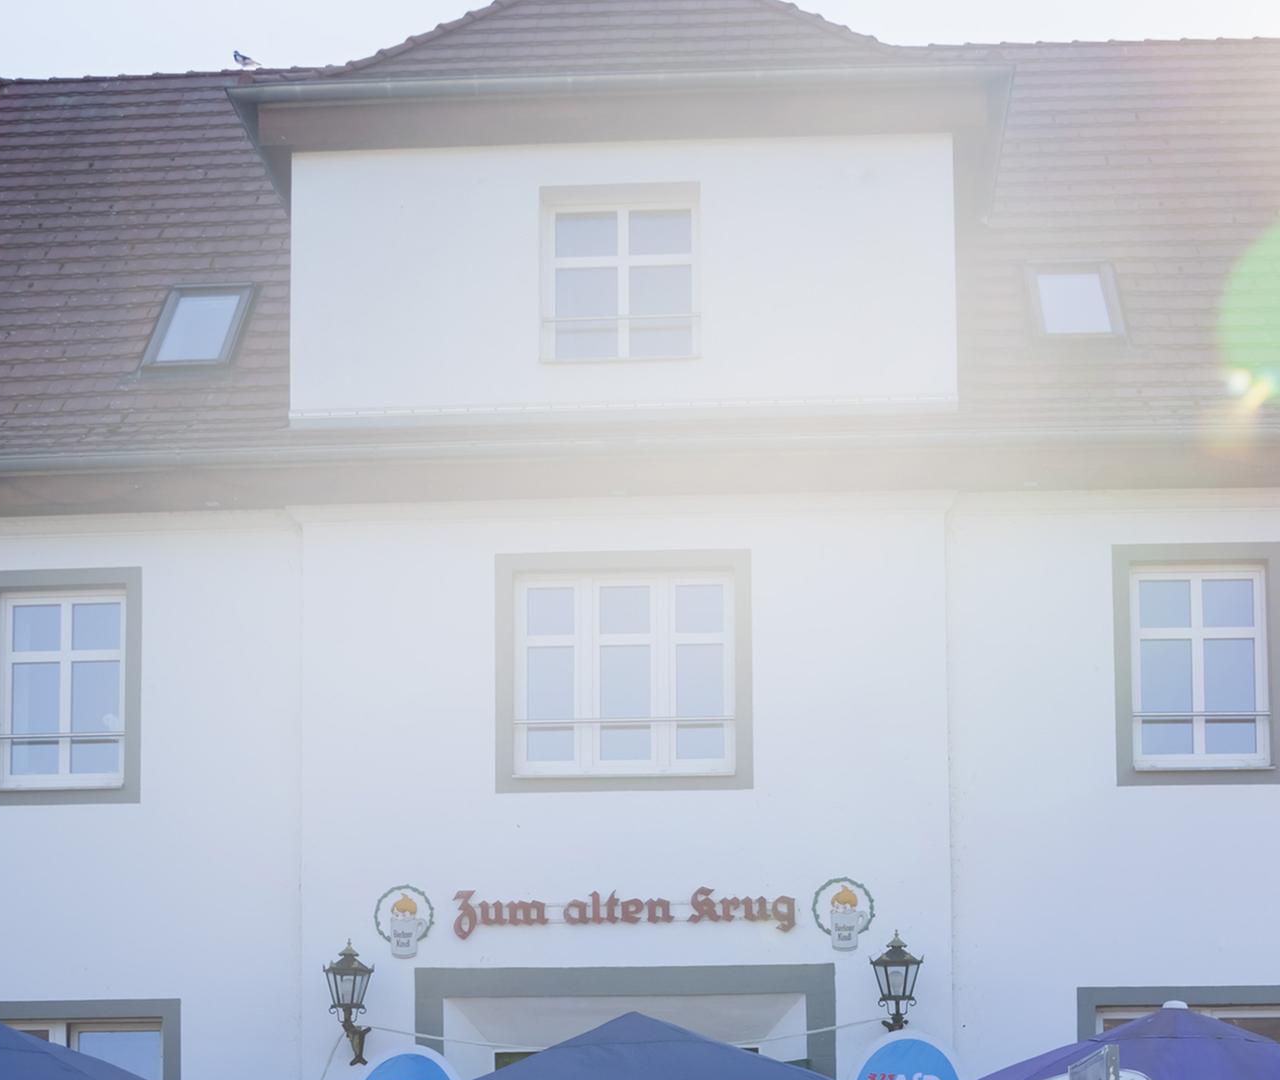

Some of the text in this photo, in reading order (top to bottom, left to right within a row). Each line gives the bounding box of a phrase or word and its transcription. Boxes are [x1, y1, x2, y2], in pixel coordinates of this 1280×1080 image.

[453, 886, 796, 940] Zum alten Krug
